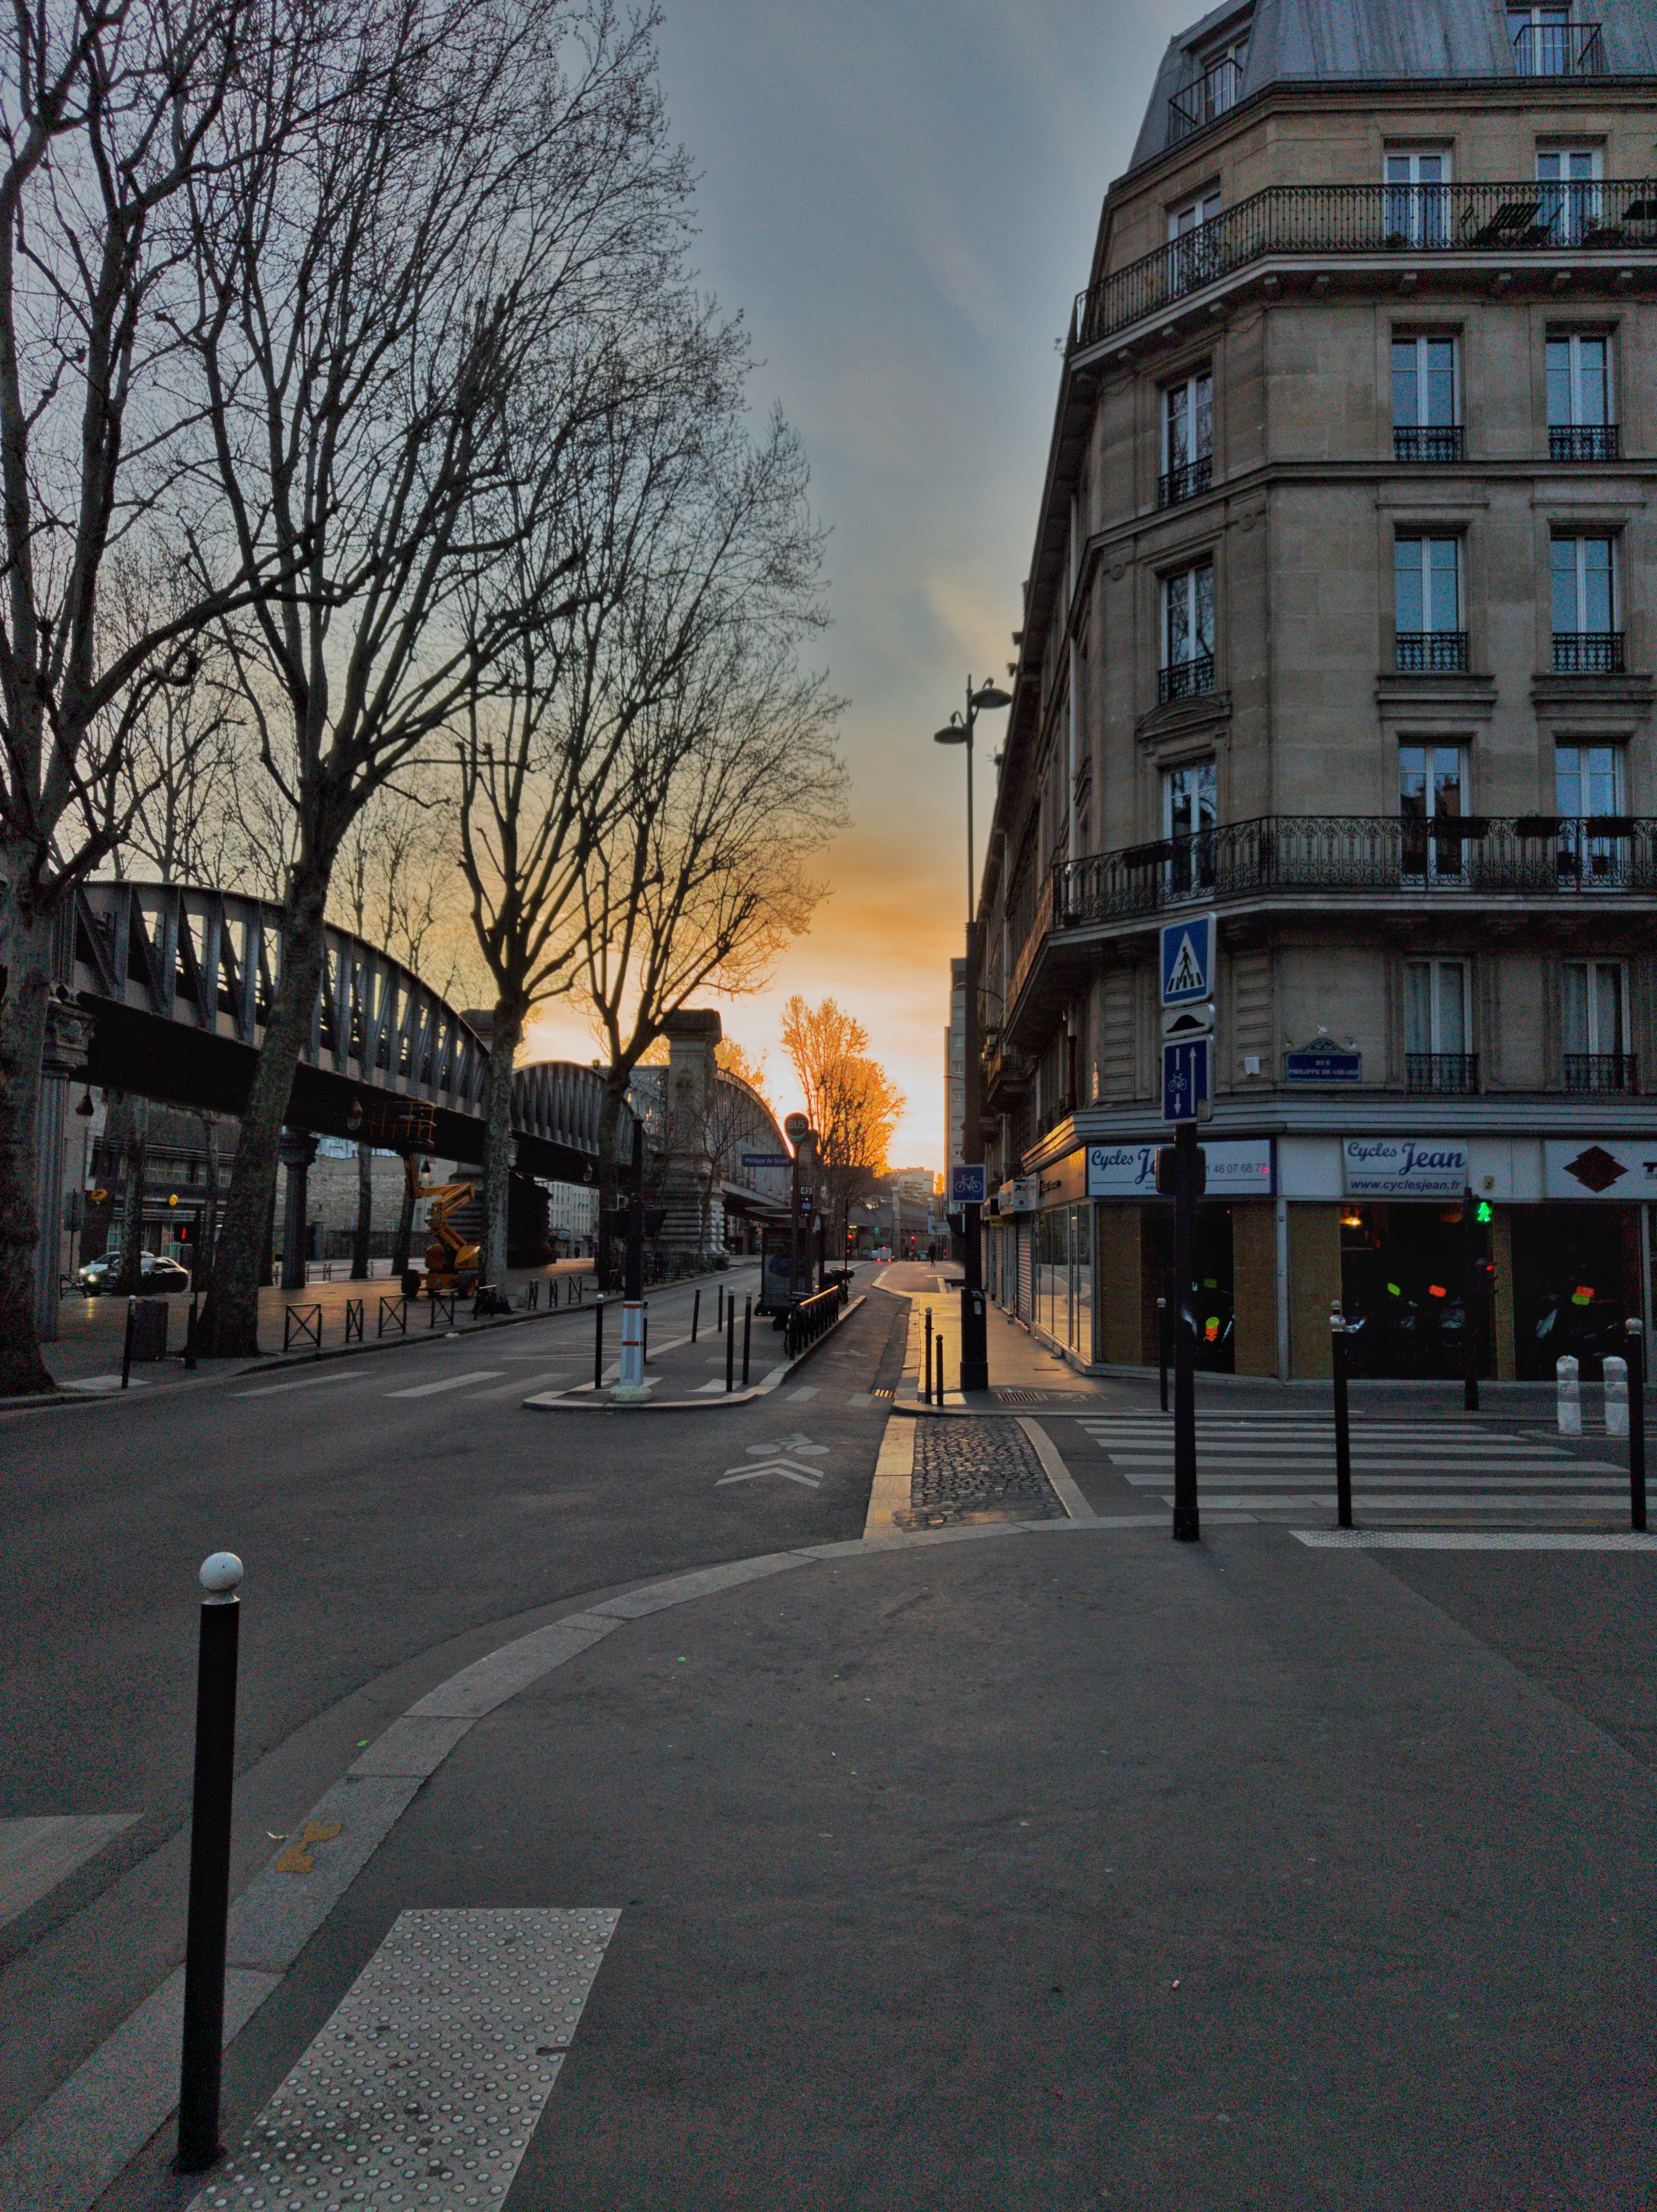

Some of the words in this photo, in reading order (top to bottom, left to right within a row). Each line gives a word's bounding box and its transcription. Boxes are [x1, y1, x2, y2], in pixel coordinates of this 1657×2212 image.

[787, 1120, 806, 1129] BUS
[1091, 1149, 1134, 1171] Cycles
[1347, 1142, 1397, 1162] Cycles
[1398, 1142, 1464, 1175] Jean
[1214, 1163, 1225, 1173] 46
[1227, 1164, 1238, 1173] 07
[1241, 1163, 1252, 1173] 68
[1351, 1180, 1461, 1192] www.cyclesjean.fr
